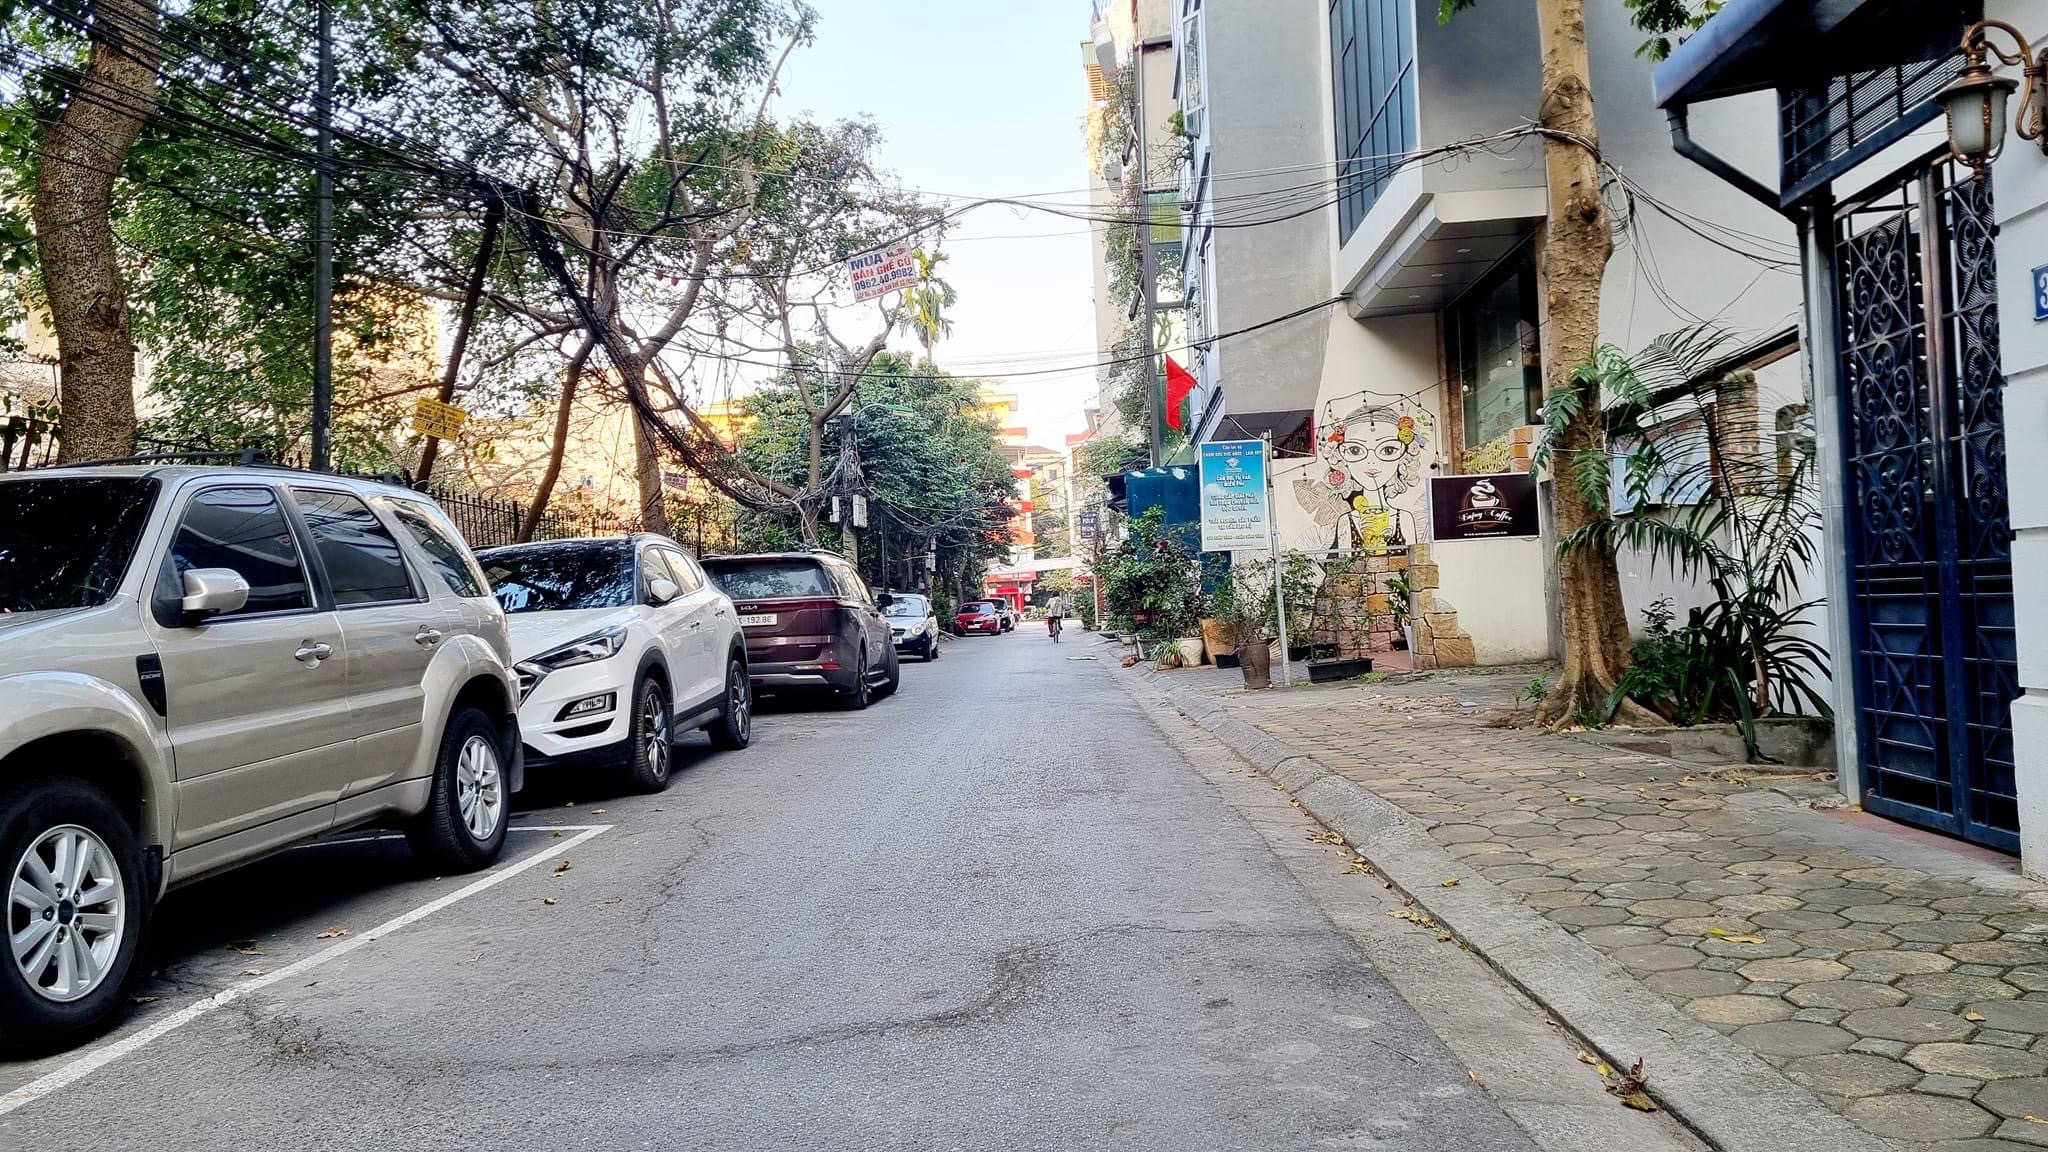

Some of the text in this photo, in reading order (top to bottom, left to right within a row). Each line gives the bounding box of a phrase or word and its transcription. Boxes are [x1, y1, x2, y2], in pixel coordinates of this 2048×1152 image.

[850, 253, 883, 271] MUA
[1459, 510, 1512, 521] Enjoy Coffee
